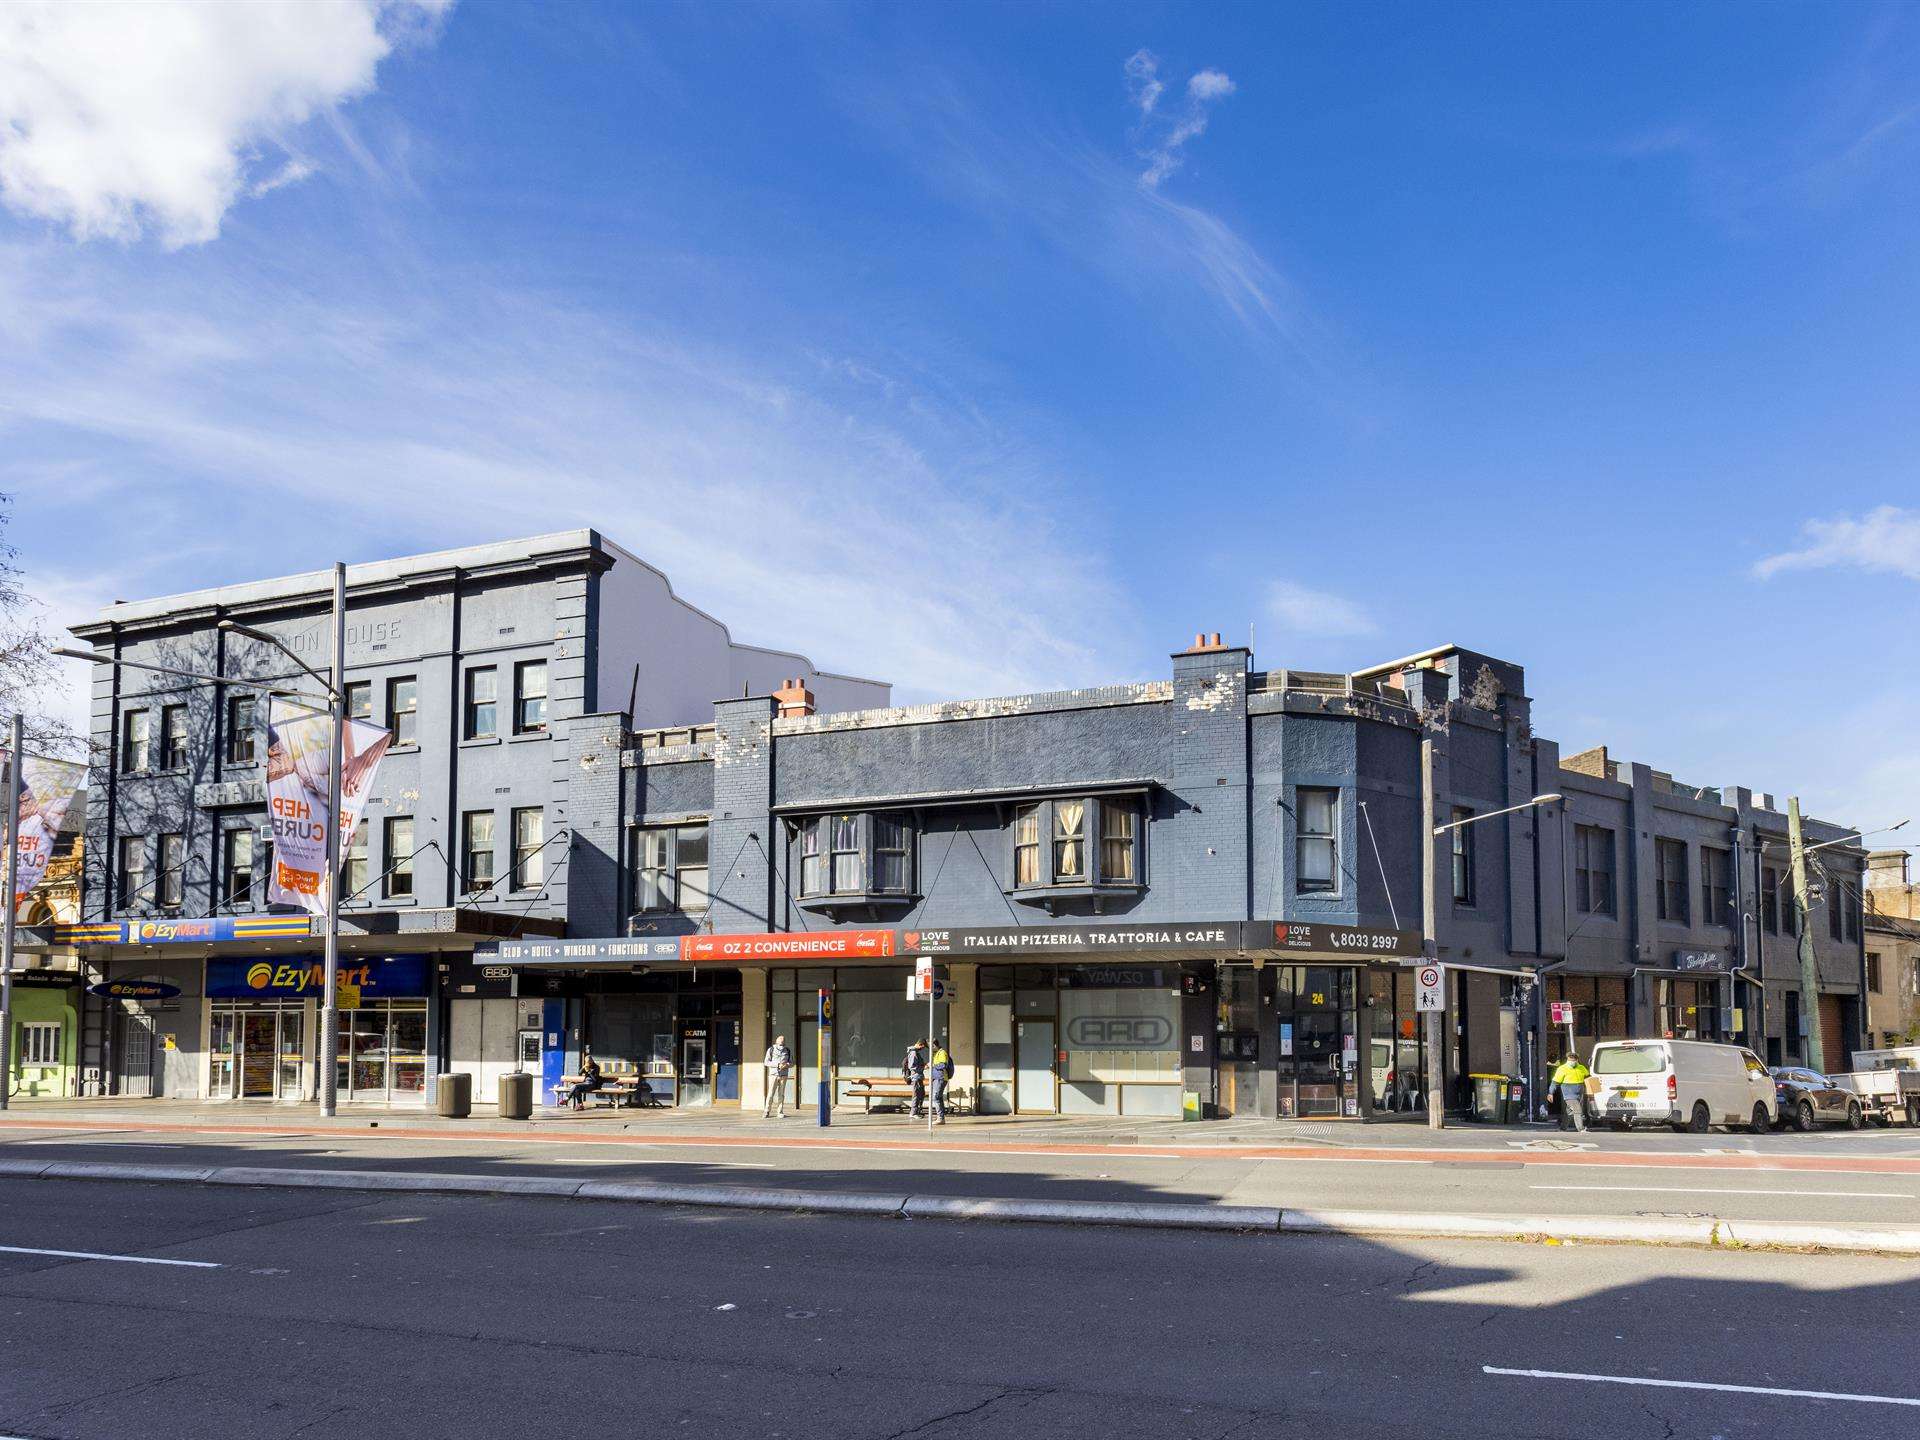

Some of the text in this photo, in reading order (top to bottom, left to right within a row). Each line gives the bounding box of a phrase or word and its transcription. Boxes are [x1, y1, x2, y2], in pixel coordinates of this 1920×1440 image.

[346, 618, 402, 646] OUSE
[155, 923, 210, 938] EzyMart
[921, 931, 949, 940] LOVE
[1289, 926, 1311, 935] LOVE
[964, 935, 1018, 946] ITALIAN
[1089, 931, 1171, 944] TRATTORIA
[1174, 932, 1182, 942] &
[1341, 933, 1398, 949] 8033 2997
[503, 943, 648, 958] CLUB HOTEL WINEBAR FUNCTIONS
[723, 939, 846, 954] OZ 2 CONVENIENCE
[1423, 973, 1436, 982] 40
[1311, 992, 1324, 1005] 24
